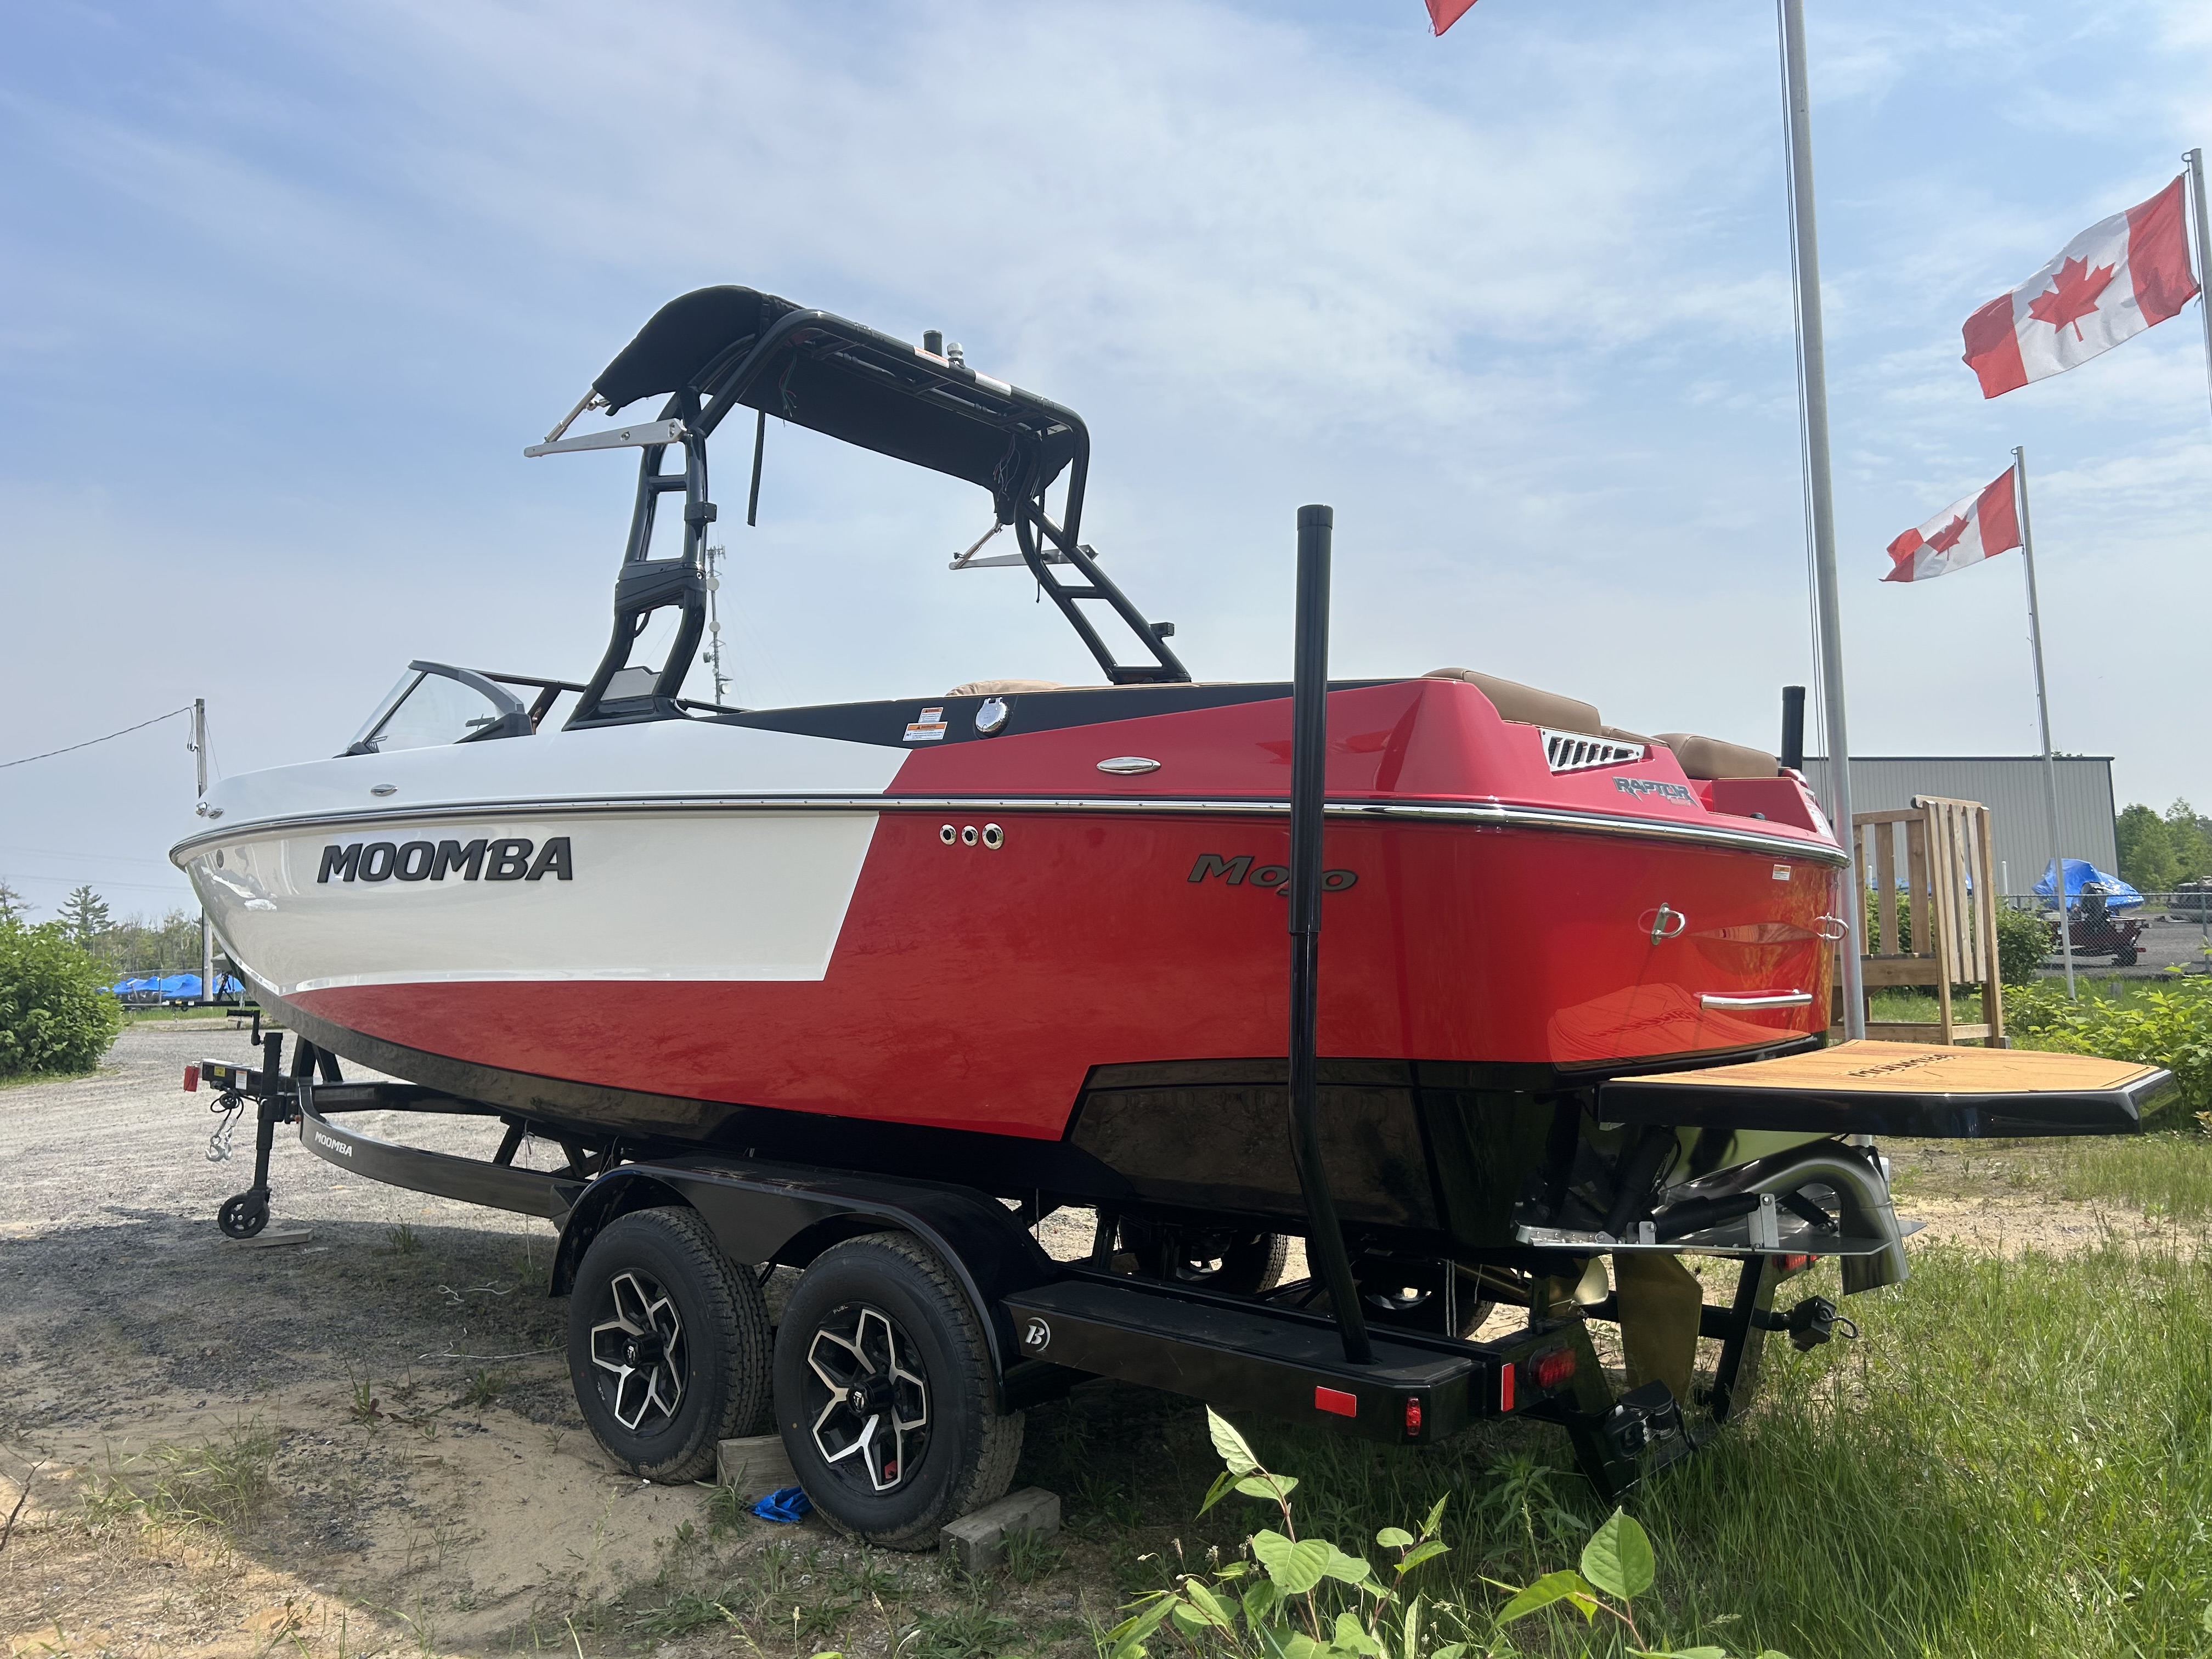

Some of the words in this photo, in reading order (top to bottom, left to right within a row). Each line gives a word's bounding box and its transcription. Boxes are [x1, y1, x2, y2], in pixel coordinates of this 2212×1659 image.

[1612, 776, 1699, 807] RAPTOR
[317, 837, 573, 883] MOOMBA
[1187, 854, 1358, 896] Moo
[315, 1131, 353, 1157] MOOMBA
[832, 1305, 849, 1314] FUEL
